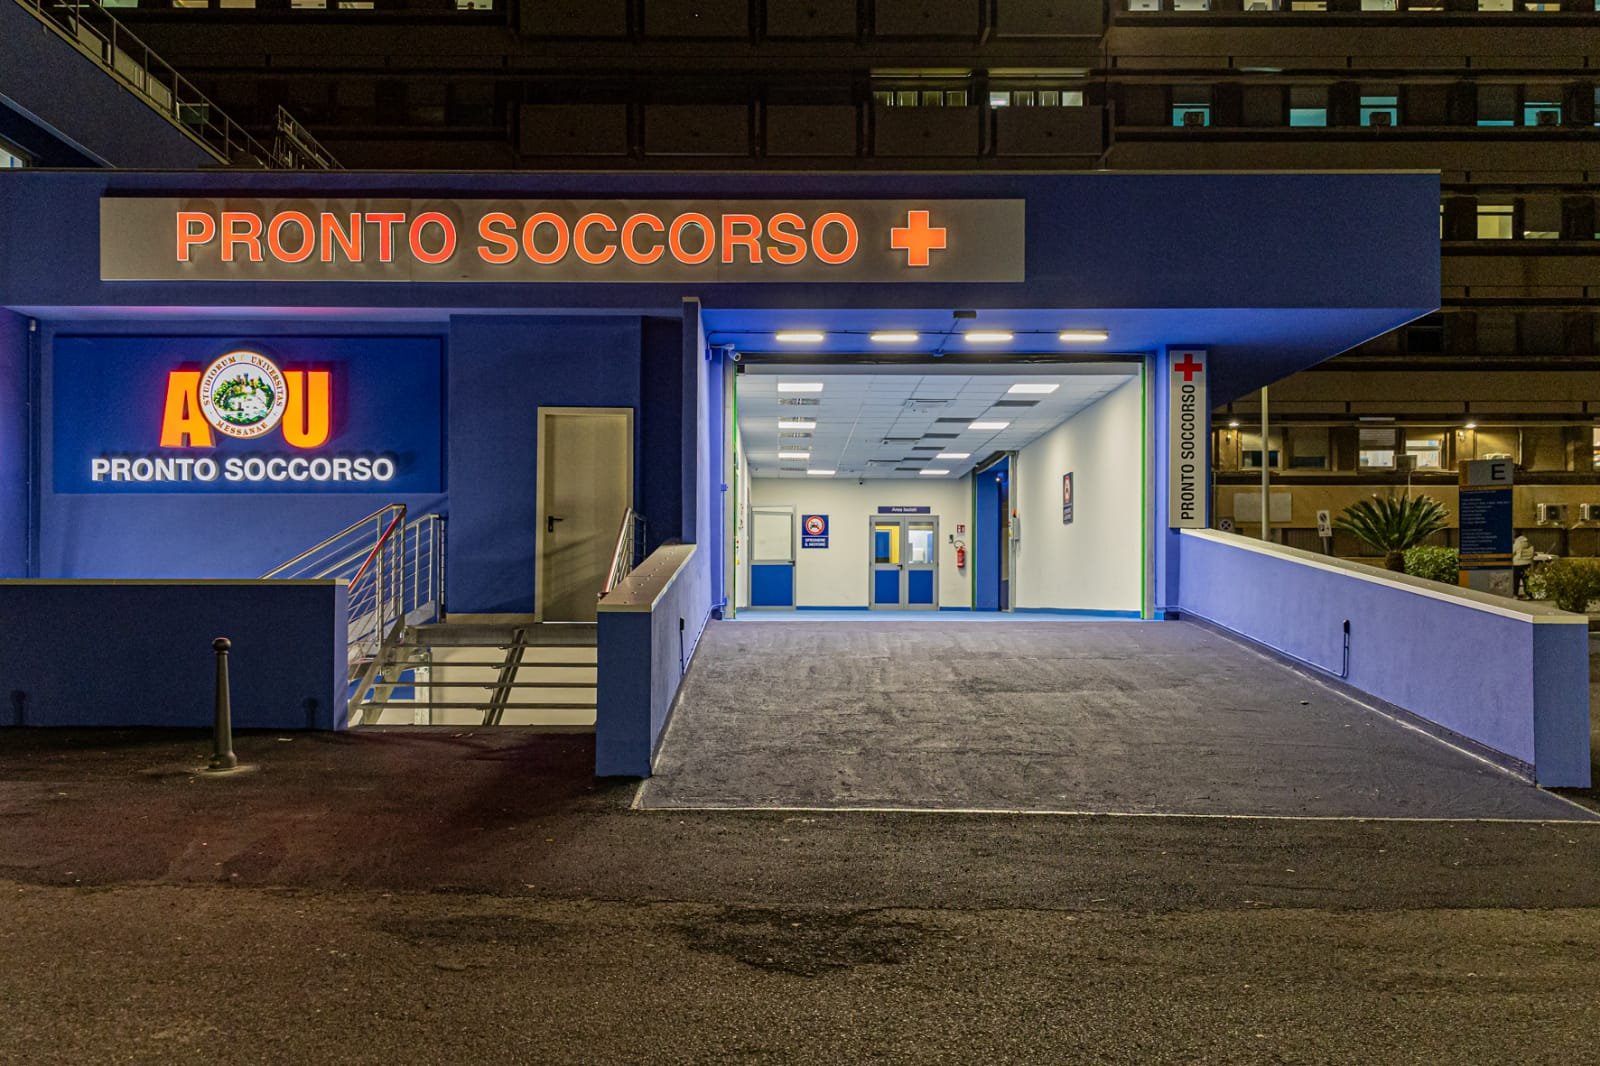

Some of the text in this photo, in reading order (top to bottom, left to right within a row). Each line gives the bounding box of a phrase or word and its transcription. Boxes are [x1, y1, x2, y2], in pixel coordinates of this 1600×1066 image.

[176, 211, 858, 264] PRONTO SOCCORSO
[203, 356, 236, 406] STUDIORUM
[251, 356, 284, 407] UNIVERSITAS
[216, 420, 268, 436] MESSANAE
[1181, 384, 1196, 520] PRONTO SOCCORSO
[91, 458, 394, 481] PRONTO SOCCORSO
[1491, 463, 1506, 480] E
